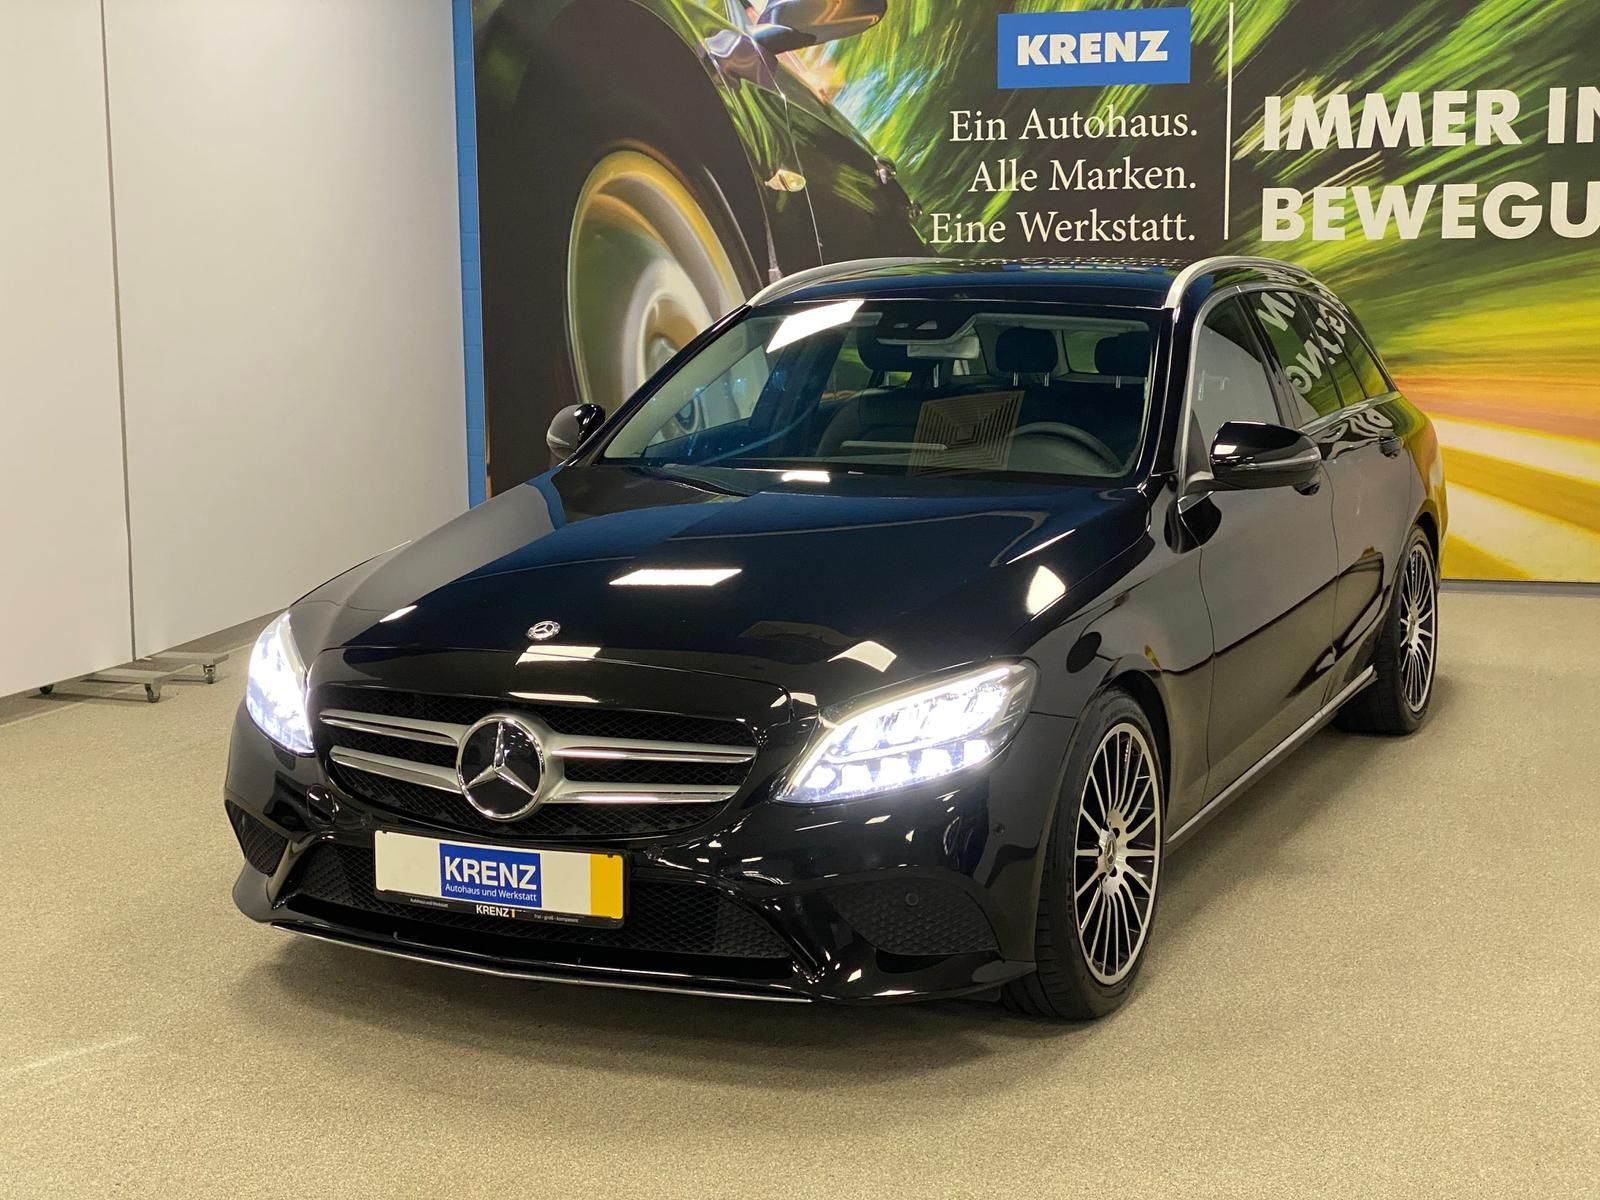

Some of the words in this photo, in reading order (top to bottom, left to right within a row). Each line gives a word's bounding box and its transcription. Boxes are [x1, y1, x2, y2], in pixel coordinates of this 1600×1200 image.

[1017, 30, 1170, 66] KRENZ
[949, 109, 1008, 142] Ein
[1018, 103, 1198, 140] Autohaus.
[1263, 88, 1523, 151] IMMER
[967, 158, 1038, 193] Alle
[1048, 155, 1197, 192] Marken.
[929, 212, 1006, 244] Eine
[1016, 208, 1196, 243] Werkstatt.
[1261, 180, 1600, 242] BEWEGU
[444, 855, 538, 891] KRENZ
[444, 883, 481, 895] Autohaus
[481, 888, 497, 898] und
[498, 889, 537, 902] Werkstatt
[475, 904, 510, 918] KRENZ
